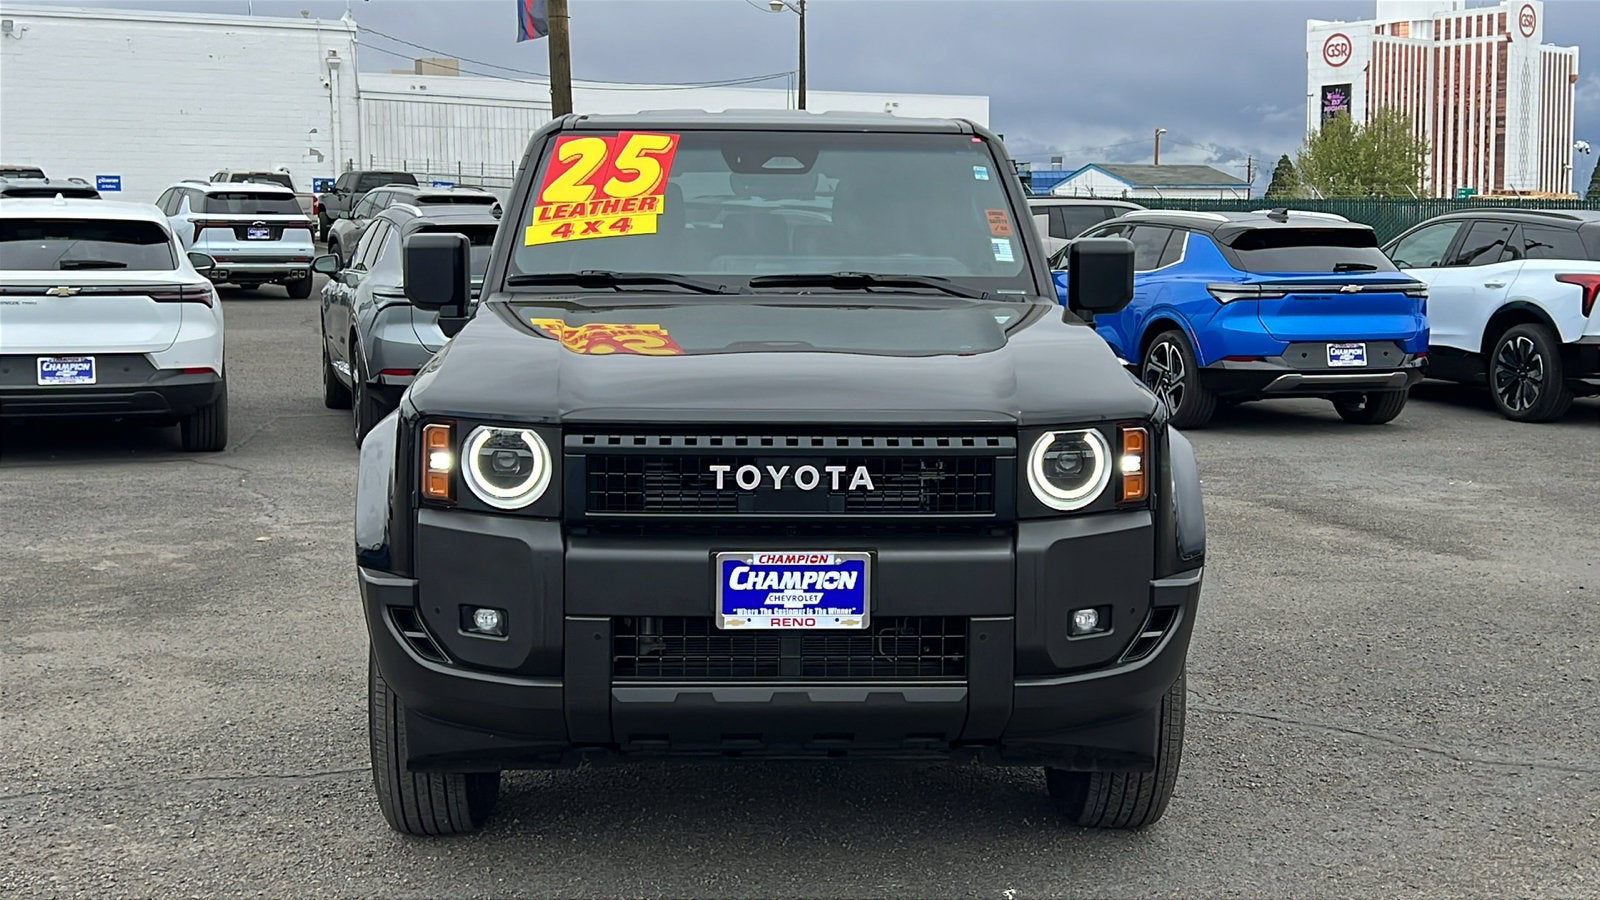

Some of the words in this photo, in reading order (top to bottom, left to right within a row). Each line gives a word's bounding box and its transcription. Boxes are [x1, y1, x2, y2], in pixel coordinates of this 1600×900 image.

[1326, 42, 1347, 57] GSR
[542, 133, 673, 203] 25
[537, 196, 659, 222] LEATHER
[42, 362, 90, 371] CHAMPION
[709, 464, 875, 491] TOYOTA
[758, 554, 829, 564] CHAMPION
[728, 566, 858, 590] CHAMPION
[768, 594, 819, 602] CHEVROLET
[760, 607, 772, 615] The
[815, 607, 826, 615] The
[770, 618, 816, 626] RENO
